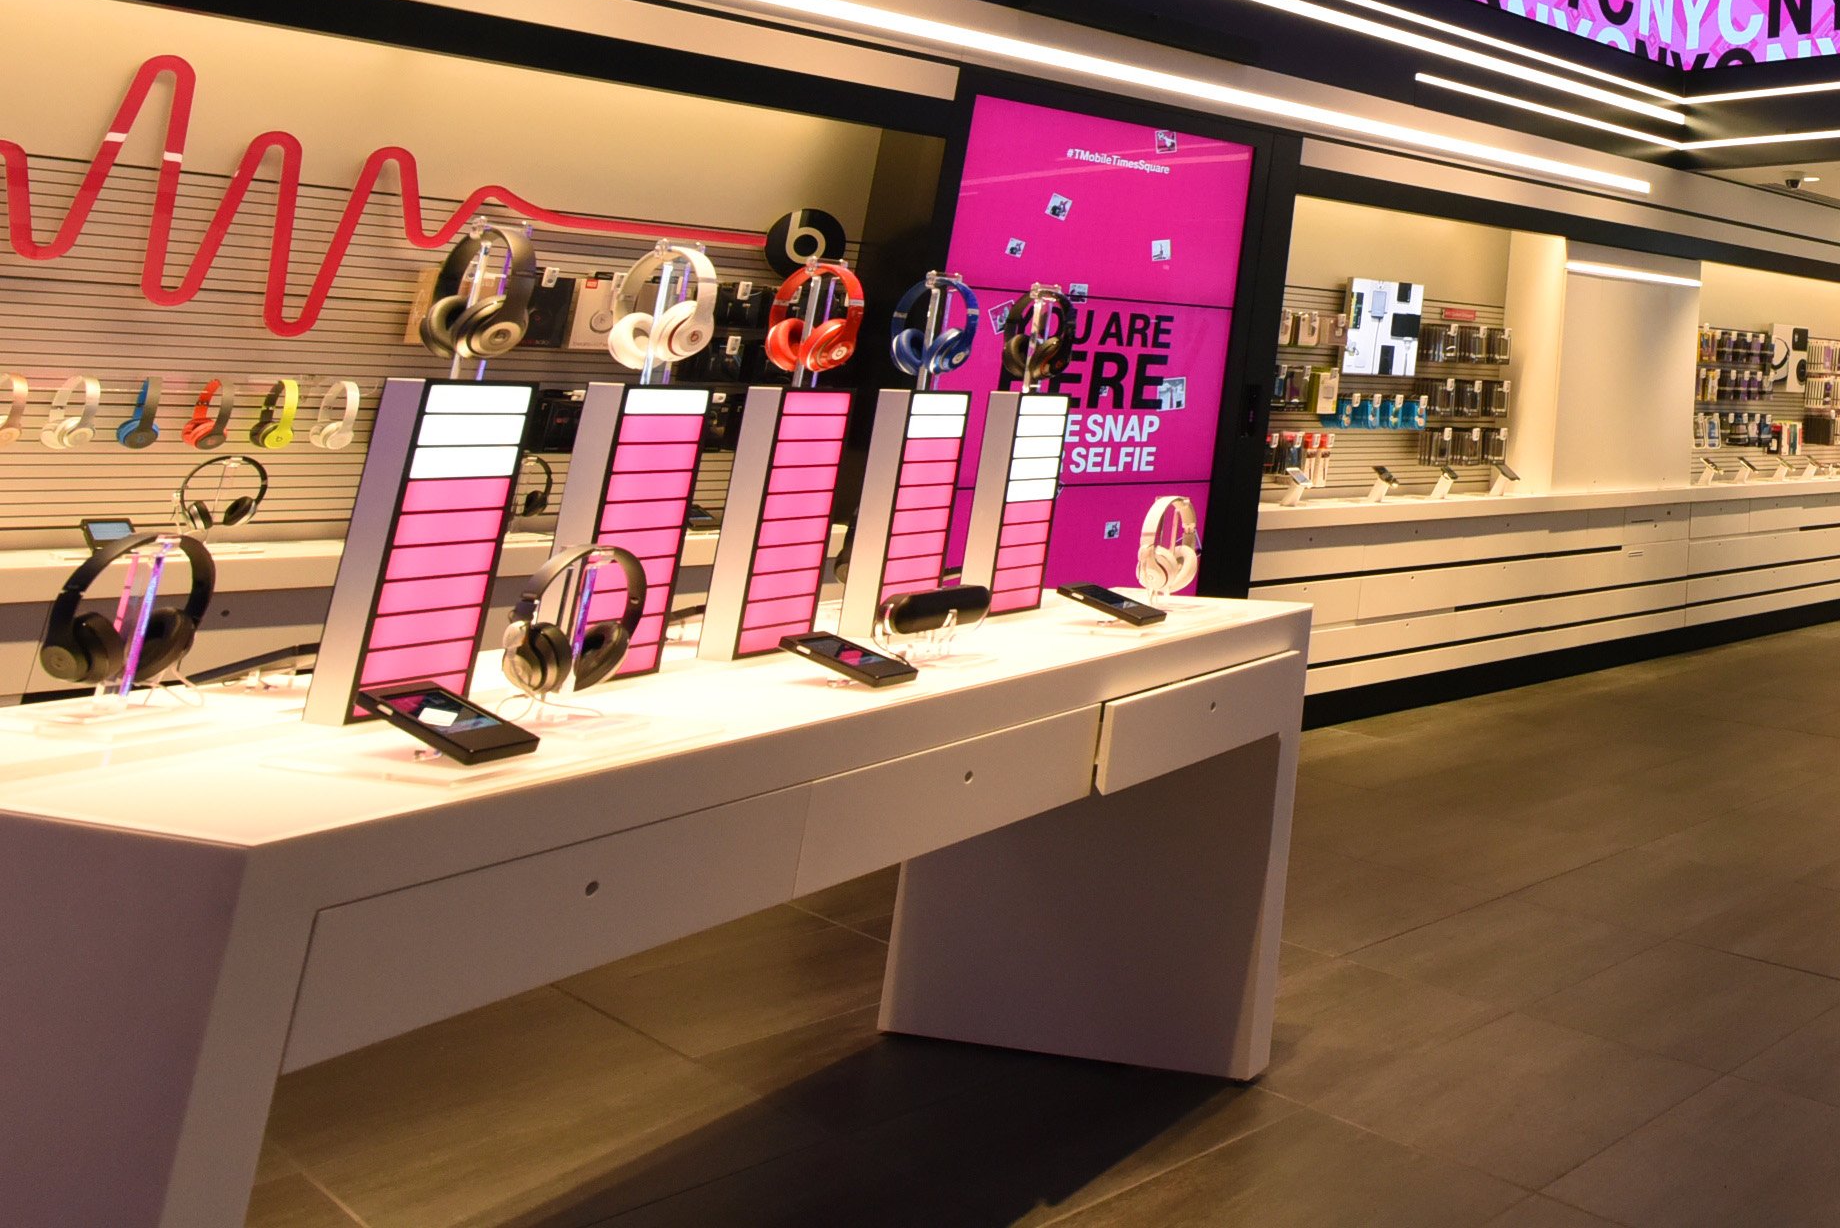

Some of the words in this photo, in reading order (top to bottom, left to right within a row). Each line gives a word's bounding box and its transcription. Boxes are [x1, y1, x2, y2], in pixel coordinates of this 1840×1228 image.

[1066, 148, 1170, 174] #TMobileTimesSquare
[1099, 312, 1174, 349] ARE
[1085, 414, 1160, 443] SNAP
[1069, 447, 1156, 474] SELFIE
